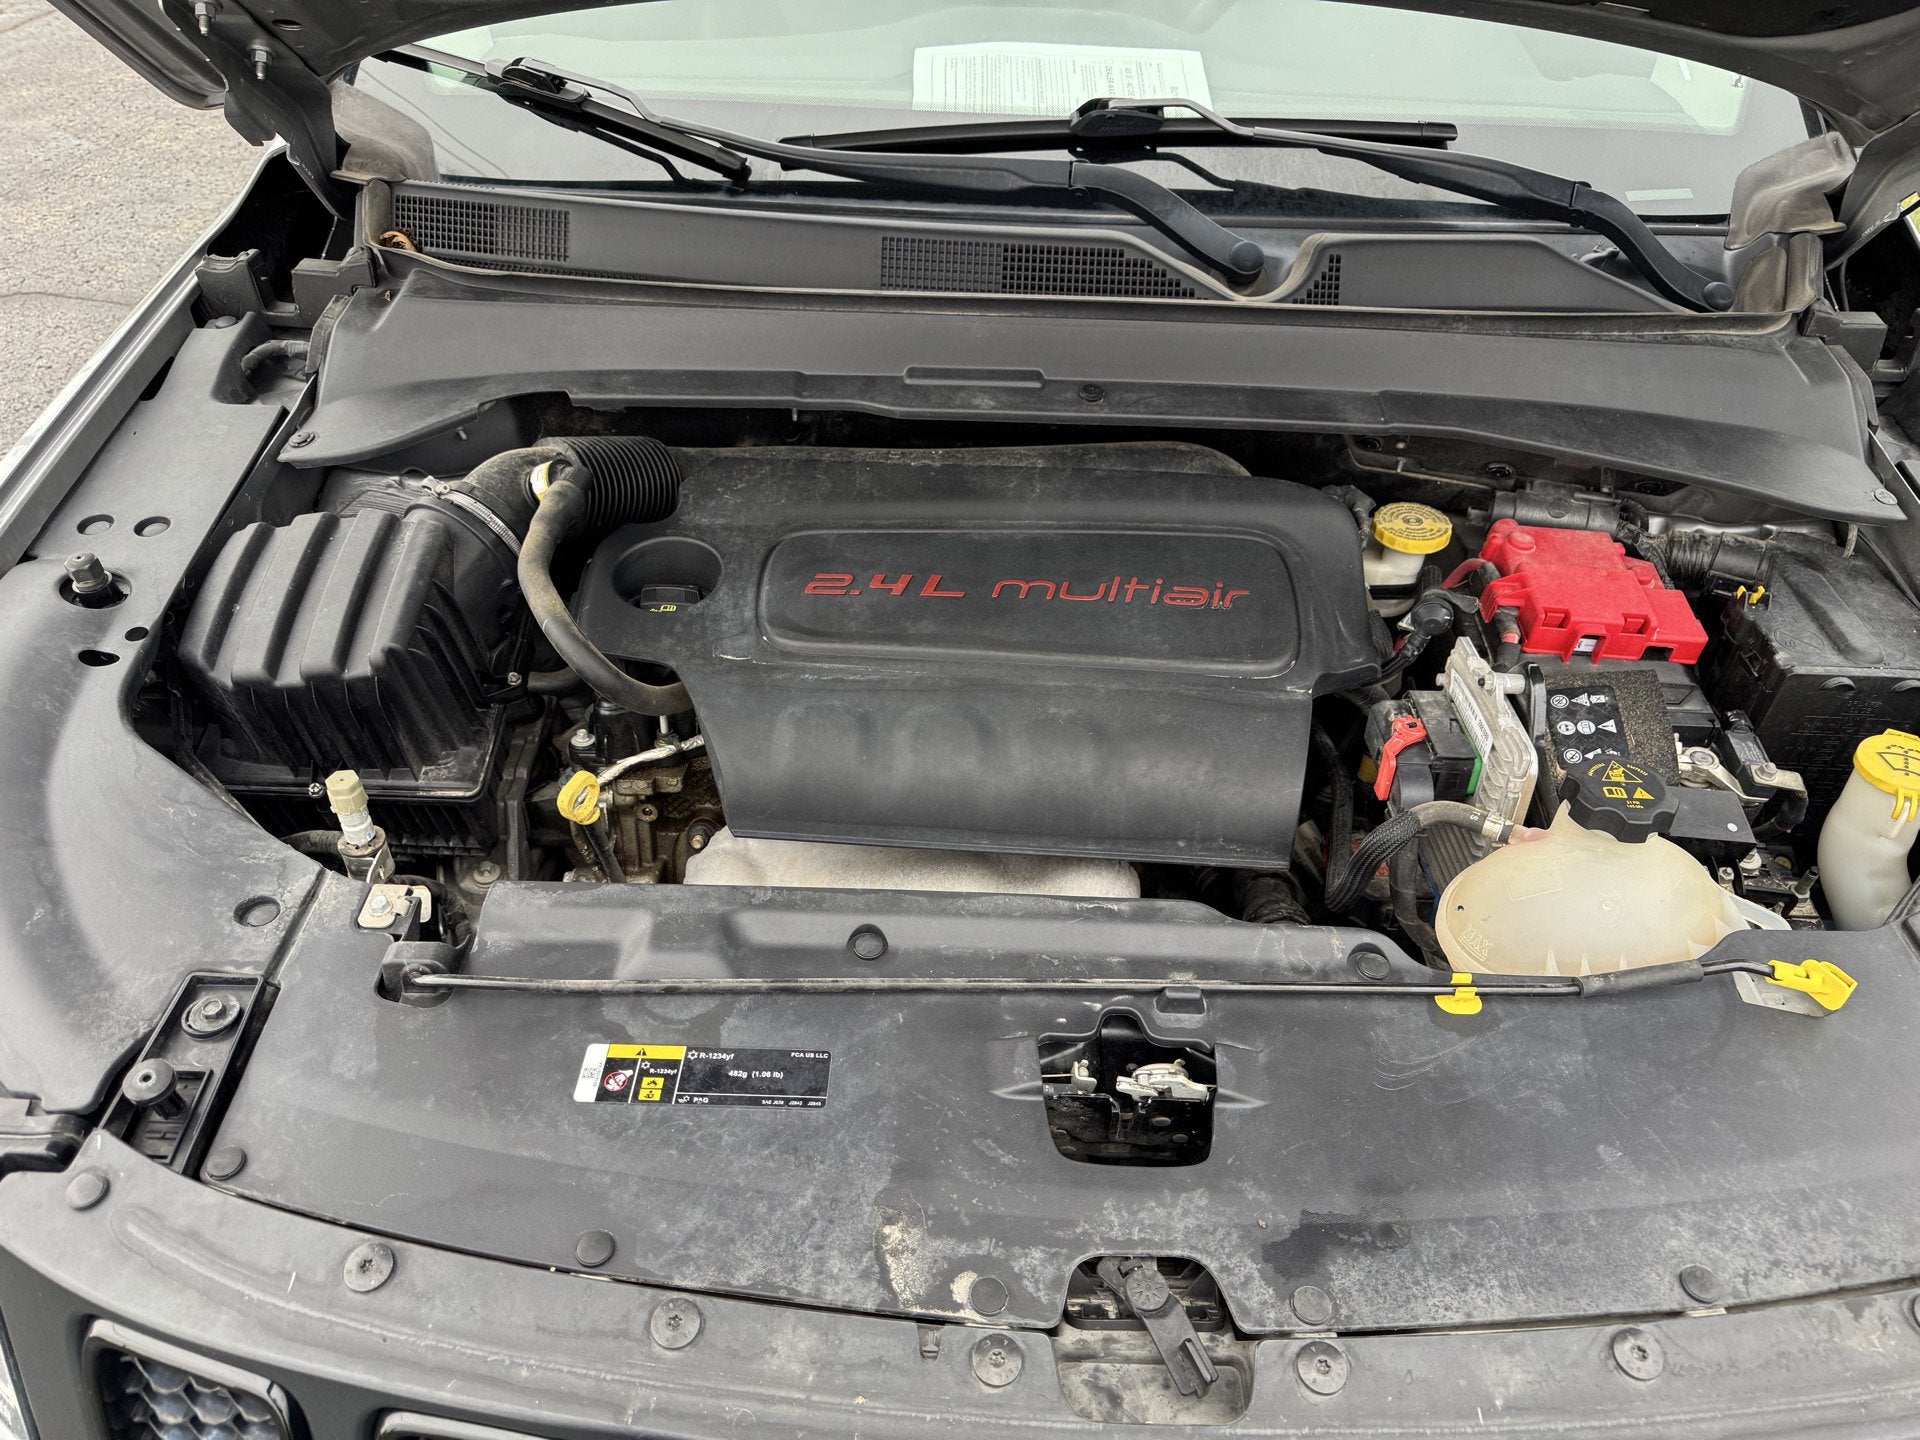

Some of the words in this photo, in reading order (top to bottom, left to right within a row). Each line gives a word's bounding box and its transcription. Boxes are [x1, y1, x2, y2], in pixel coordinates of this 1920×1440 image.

[991, 576, 1250, 608] multiair
[699, 1052, 735, 1061] R-1234yf
[728, 1070, 748, 1079] 482g
[772, 1071, 784, 1080] lb)
